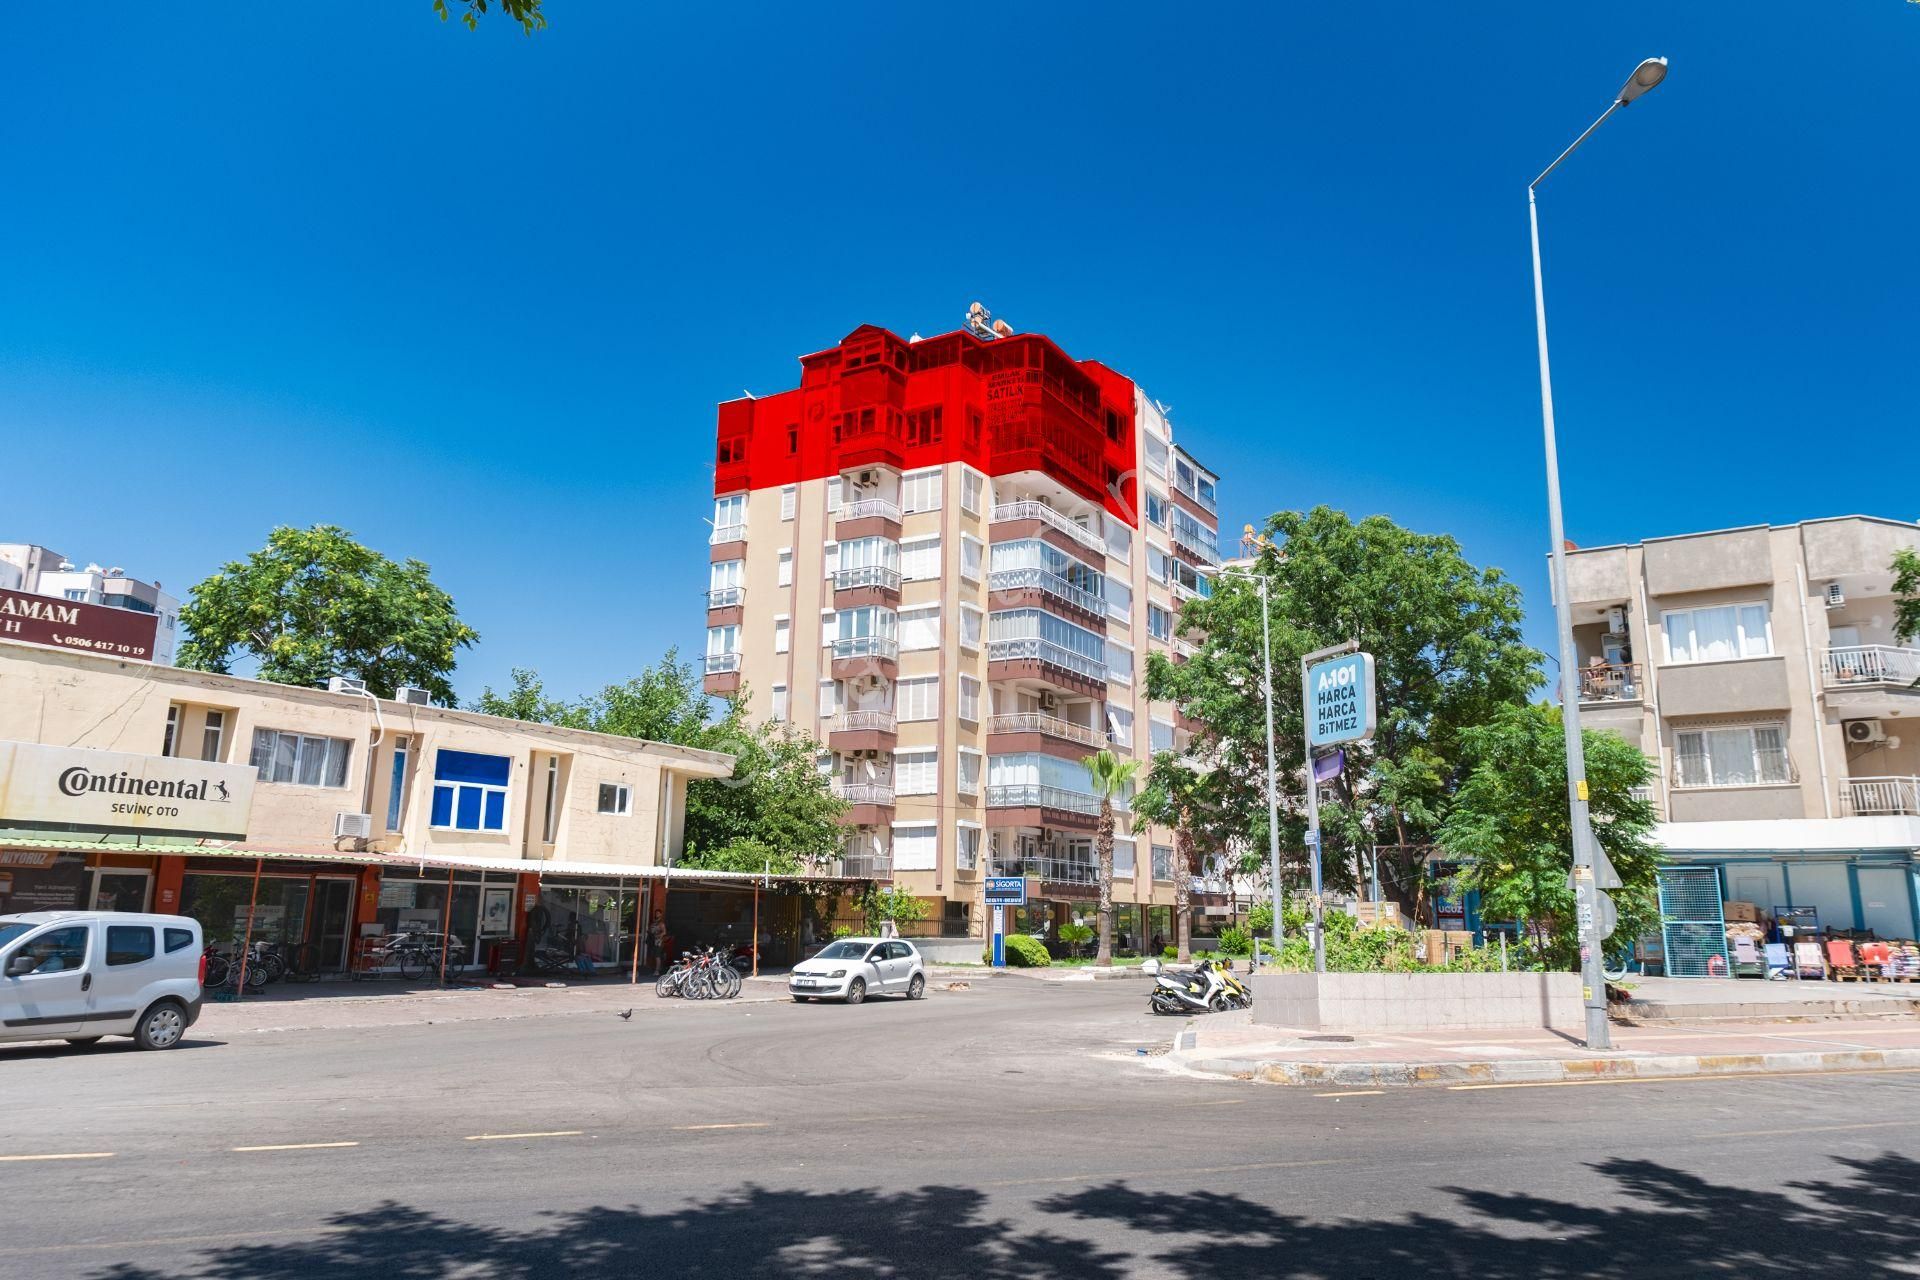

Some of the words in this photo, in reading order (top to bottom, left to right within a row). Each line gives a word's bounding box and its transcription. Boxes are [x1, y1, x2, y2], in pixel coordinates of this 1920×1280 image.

[0, 596, 81, 625] AMAM
[64, 636, 92, 648] 0506
[94, 641, 115, 651] 417
[117, 644, 130, 653] 10
[133, 647, 145, 655] 19
[1318, 685, 1356, 705] HARCA
[1318, 701, 1357, 721] HARCA
[58, 766, 208, 801] Continental
[111, 802, 154, 817] SEVİNÇ
[156, 806, 179, 817] OTO
[1438, 905, 1463, 914] UCUZ
